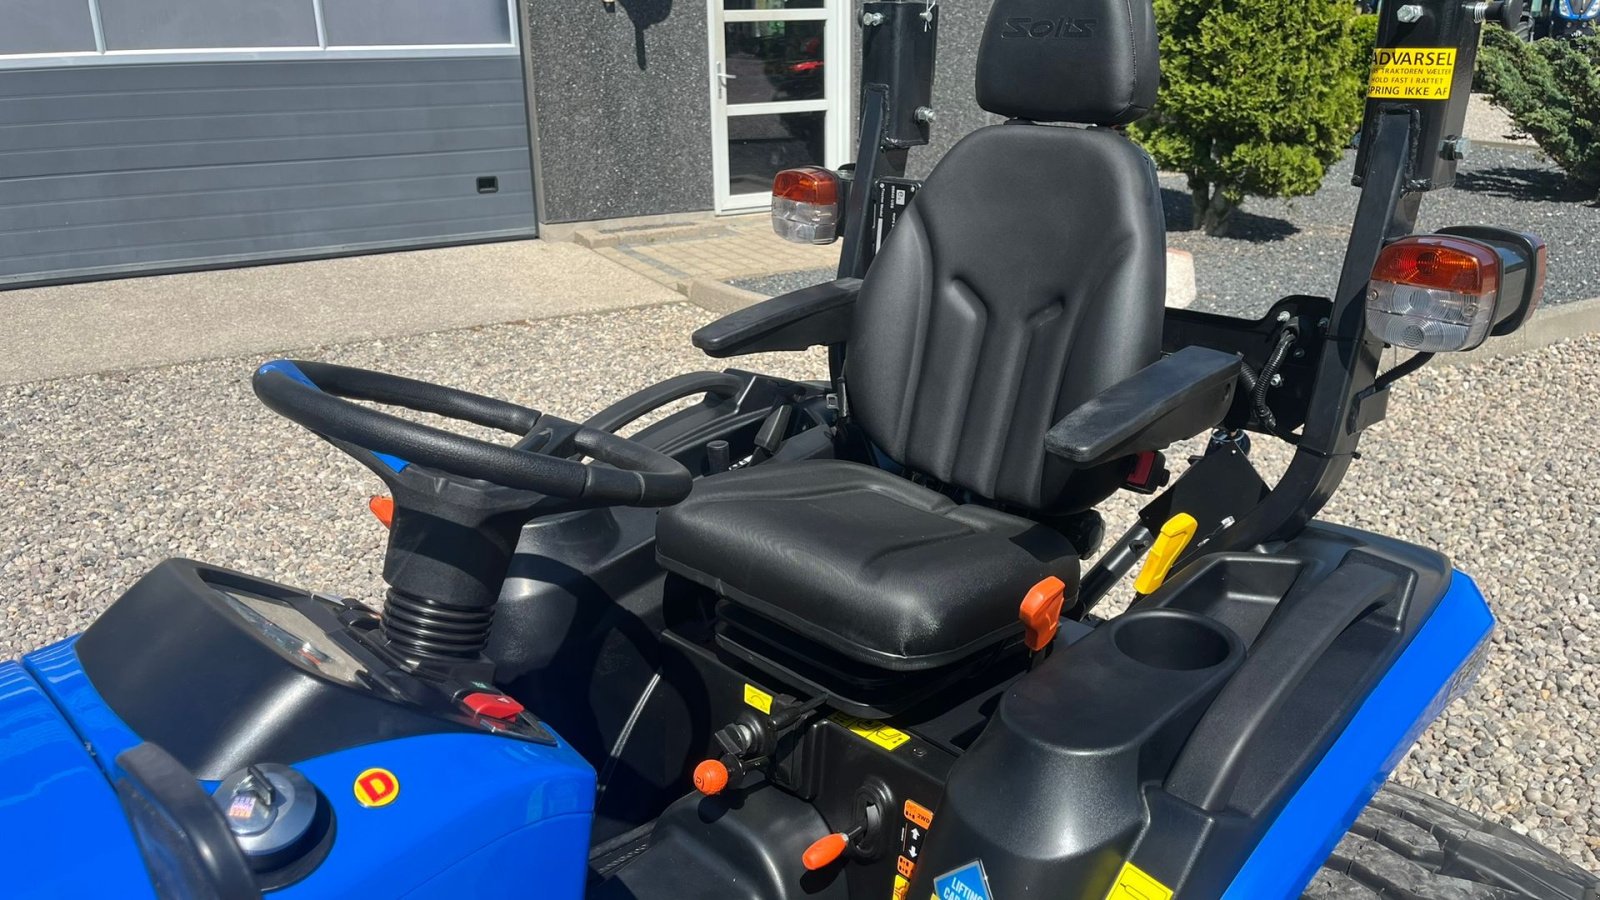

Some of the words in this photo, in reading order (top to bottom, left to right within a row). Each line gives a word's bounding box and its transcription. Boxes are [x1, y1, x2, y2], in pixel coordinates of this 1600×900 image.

[1372, 52, 1453, 66] ADVARSEL
[1381, 67, 1424, 75] TRAKTOREN
[1415, 77, 1444, 85] RATTET
[1404, 86, 1430, 96] IKKE
[1434, 87, 1448, 96] AF
[358, 771, 394, 803] D
